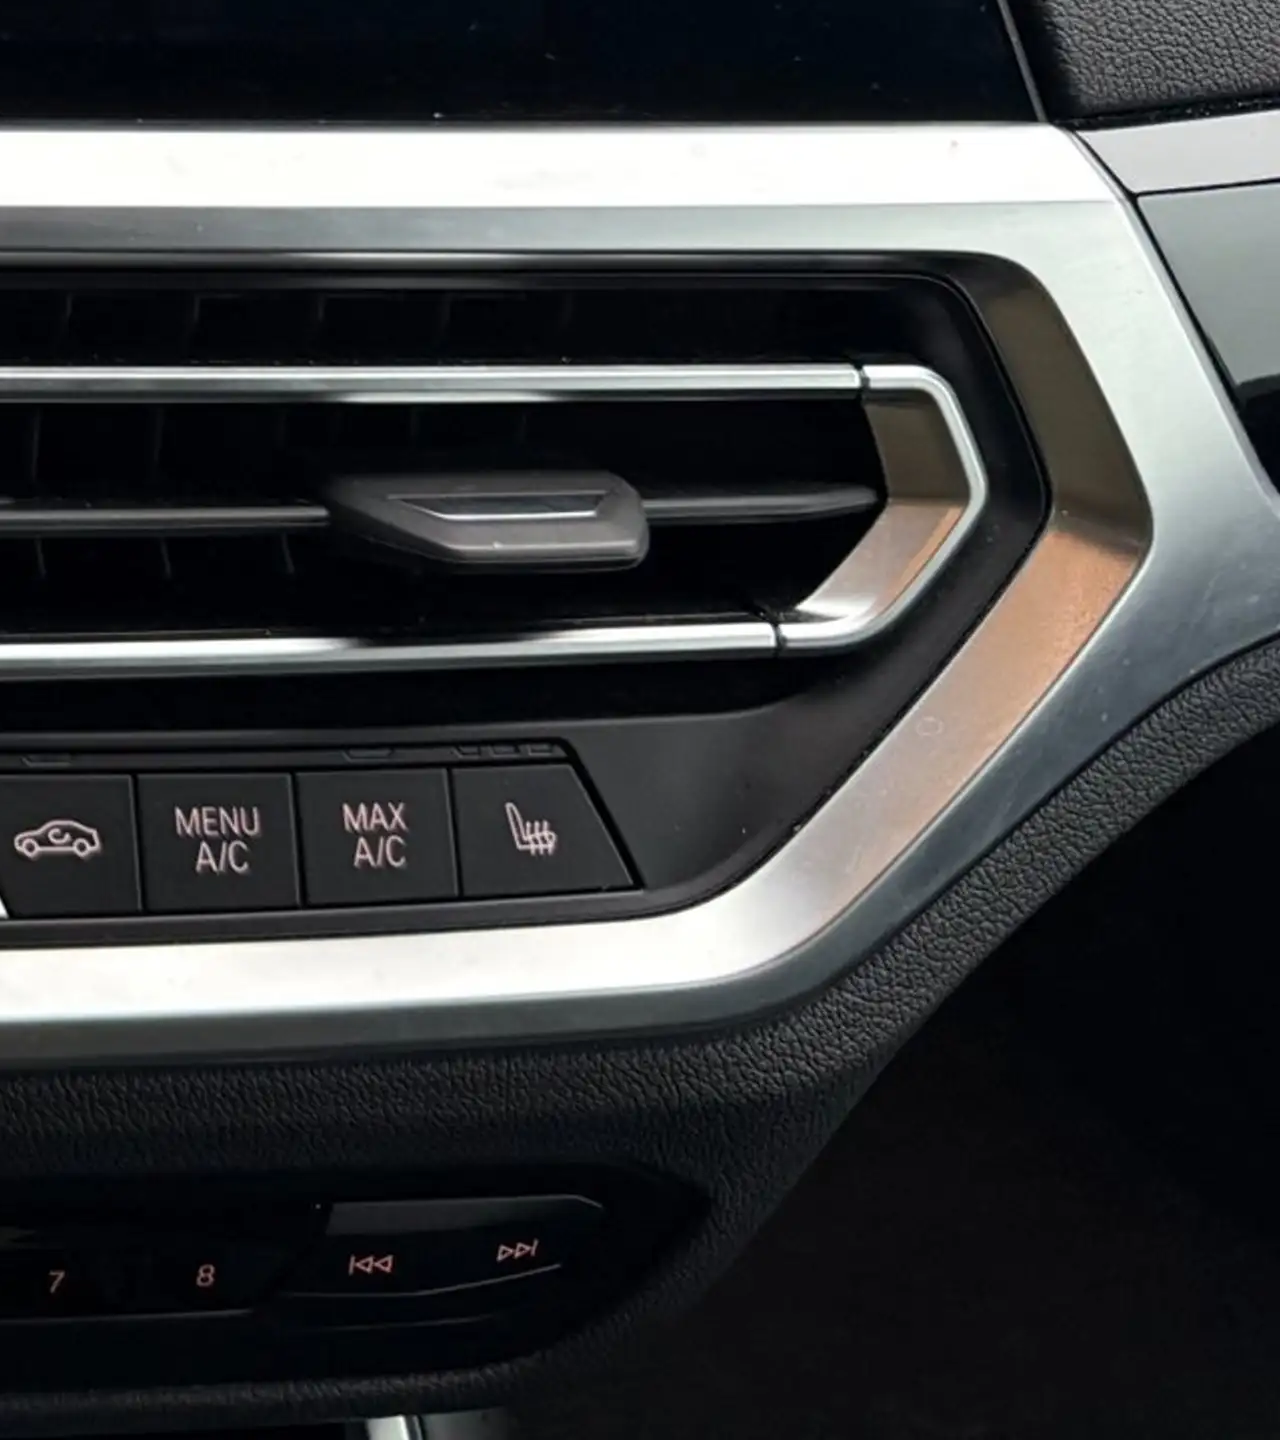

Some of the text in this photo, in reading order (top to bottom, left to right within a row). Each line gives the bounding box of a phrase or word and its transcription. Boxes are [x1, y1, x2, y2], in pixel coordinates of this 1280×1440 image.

[175, 806, 260, 837] MENU
[342, 802, 407, 831] MAX
[195, 842, 249, 873] A/C
[354, 835, 406, 868] A/C
[49, 1270, 66, 1294] 7
[196, 1264, 215, 1287] 8
